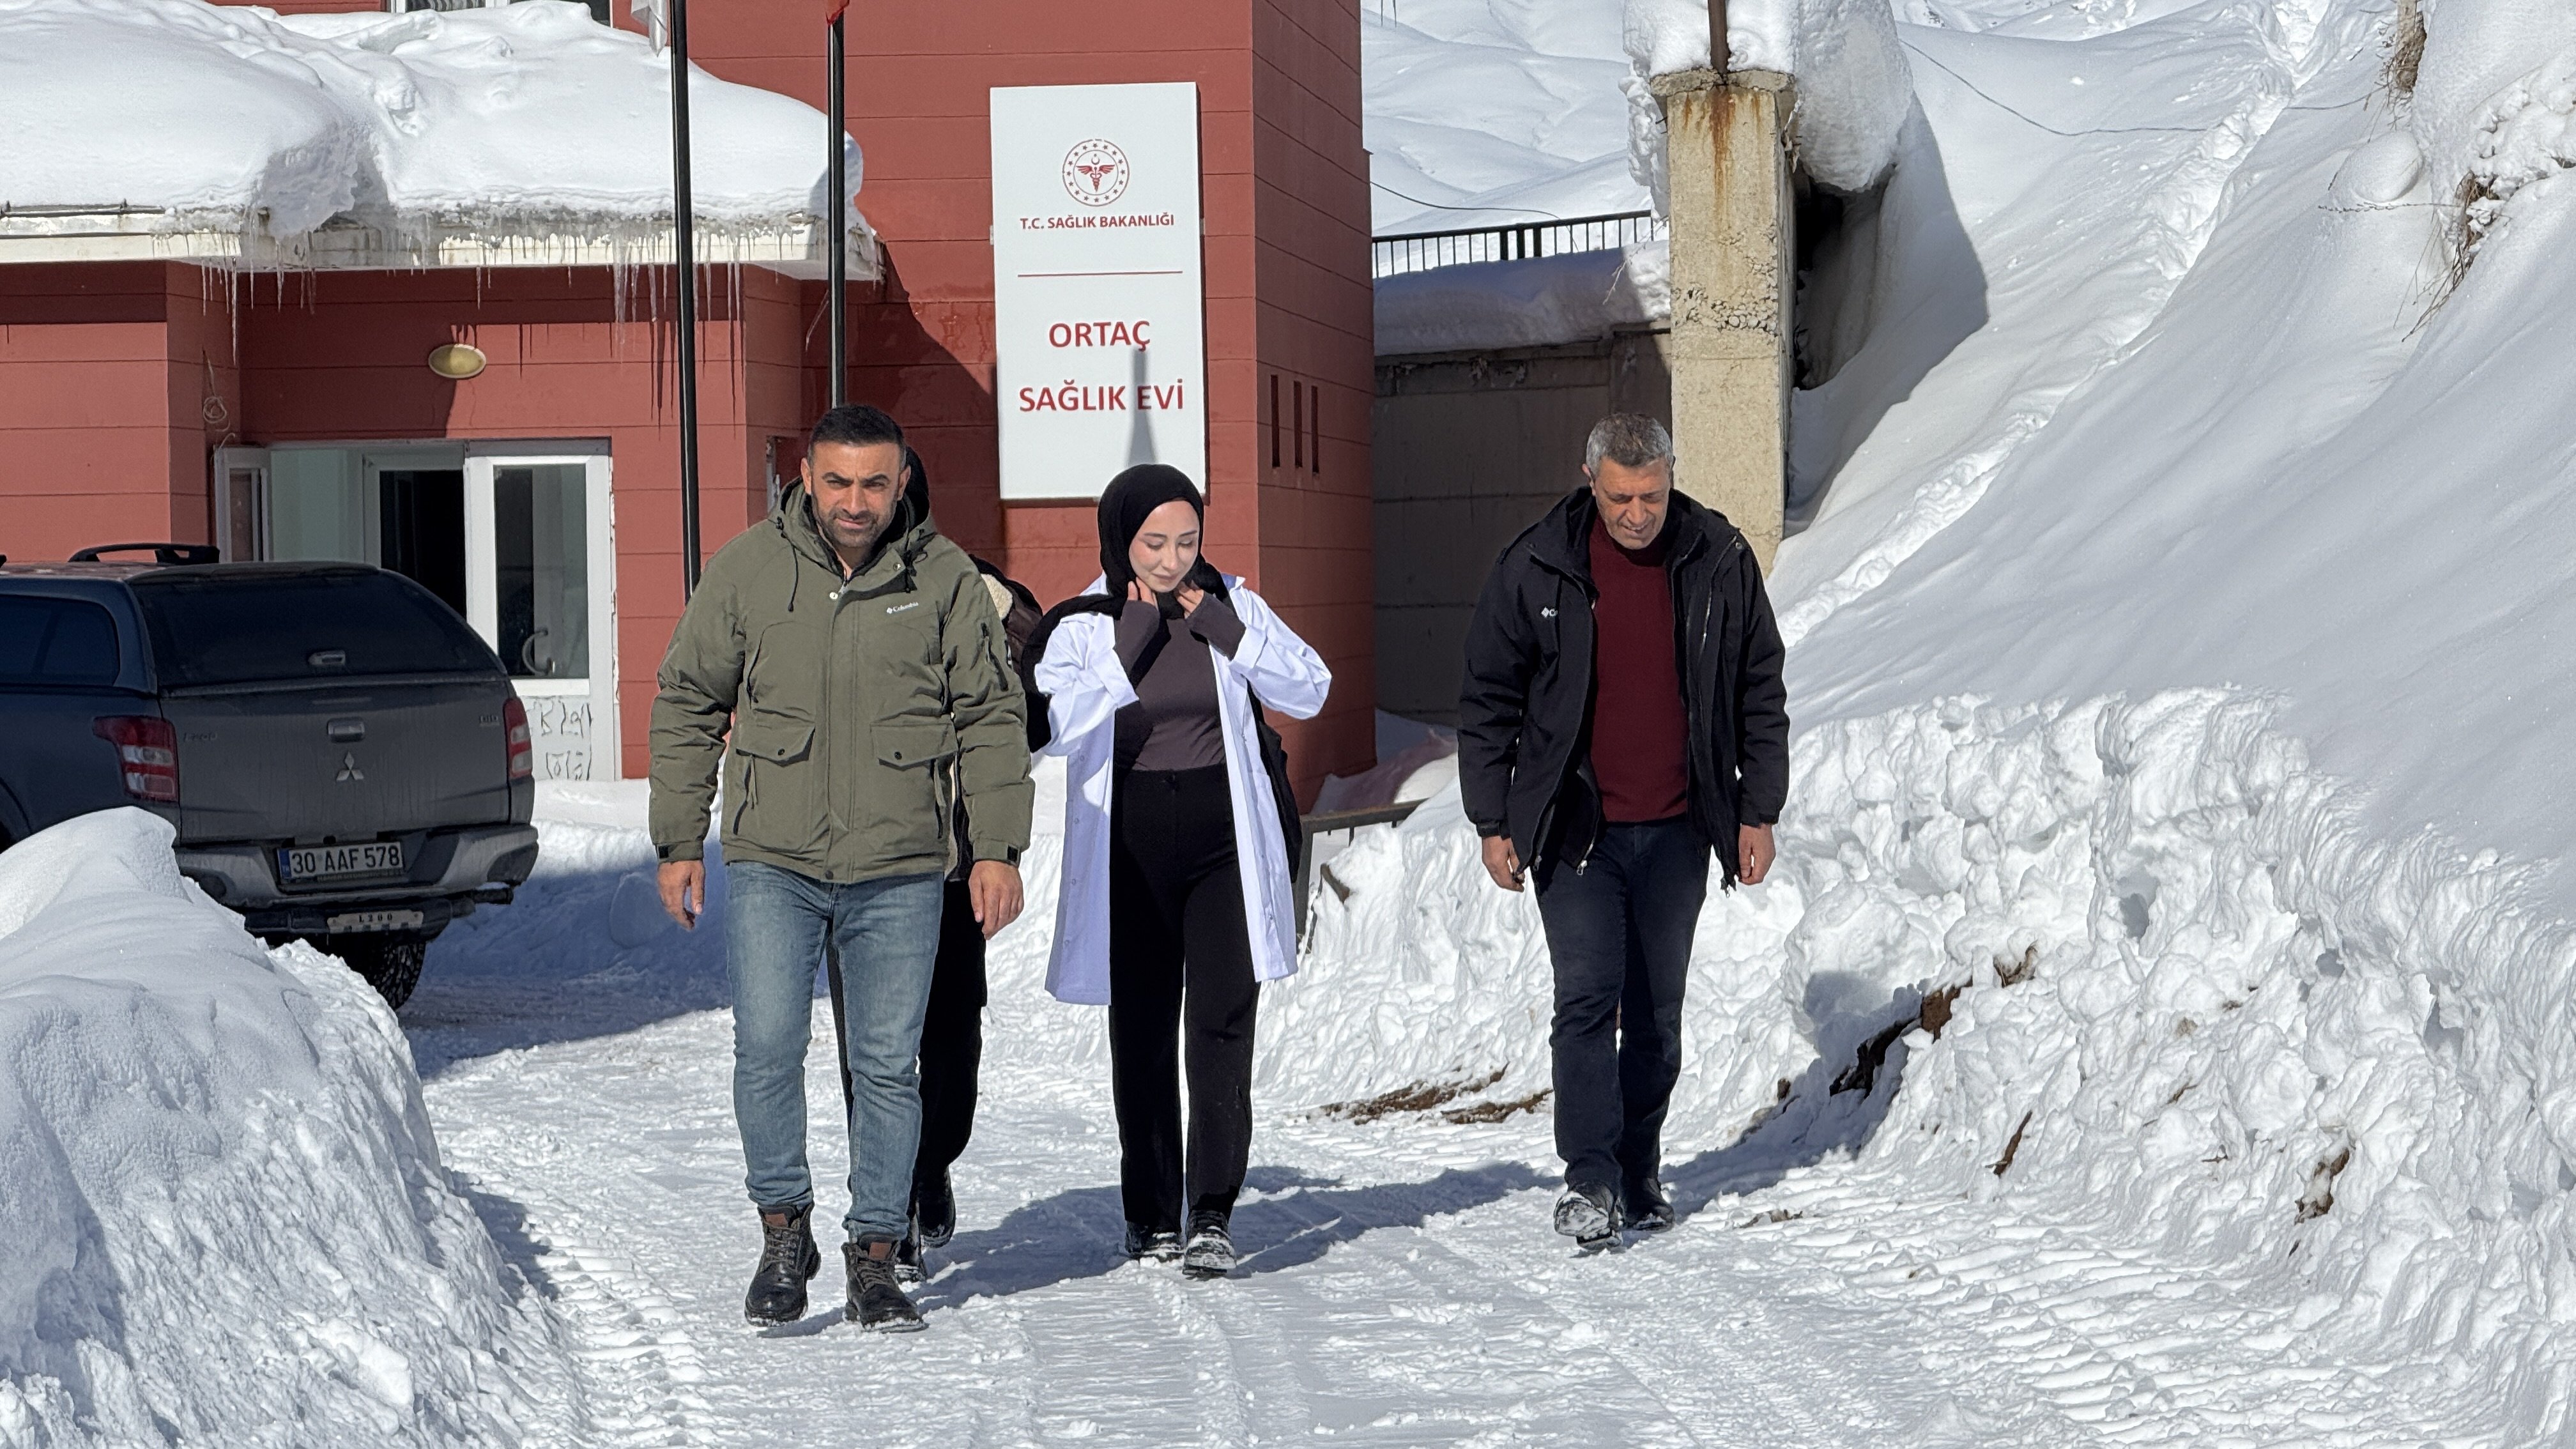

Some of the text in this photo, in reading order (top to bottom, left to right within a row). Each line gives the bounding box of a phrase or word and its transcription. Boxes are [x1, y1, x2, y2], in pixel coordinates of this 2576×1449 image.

[1020, 212, 1174, 229] T.C. SAĞLIK BAKANLIĞI
[1049, 320, 1150, 352] ORTAÇ
[1019, 378, 1183, 412] SAĞLIK EVİ
[291, 852, 316, 874] 30
[325, 848, 358, 871] AAF
[364, 845, 400, 868] 578
